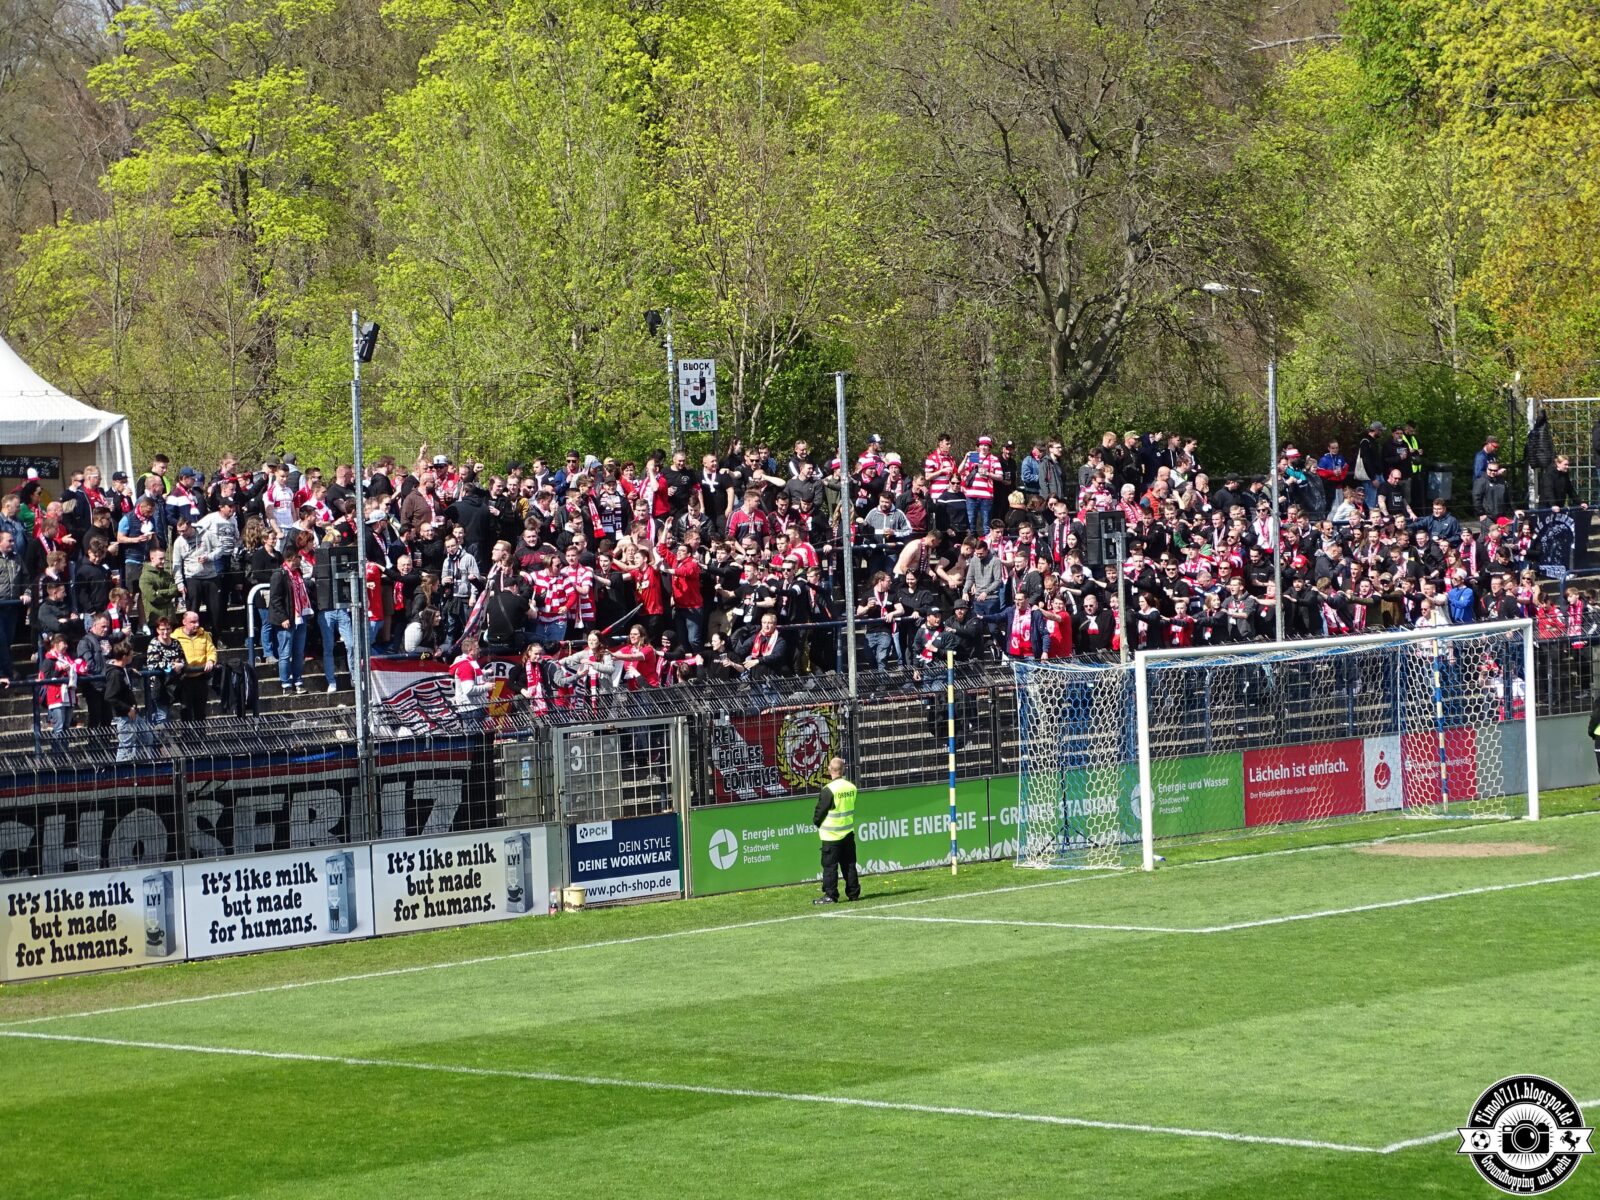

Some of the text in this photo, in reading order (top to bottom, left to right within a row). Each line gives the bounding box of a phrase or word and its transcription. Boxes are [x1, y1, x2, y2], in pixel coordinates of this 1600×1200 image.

[683, 362, 710, 371] BLOCK
[690, 376, 707, 407] J
[713, 725, 736, 747] RED
[570, 745, 583, 771] 3
[718, 745, 764, 769] EAGLES
[723, 766, 780, 792] COTTBUS
[1249, 758, 1349, 782] Lächeln ist einfach.
[1158, 778, 1229, 793] Energie und Wasser
[589, 826, 608, 836] PCH
[858, 816, 909, 842] GRÜNE
[914, 811, 976, 836] ENERGIE
[1000, 801, 1054, 826] GRÜNES
[1059, 796, 1118, 819] STADION
[742, 823, 818, 841] Energie und Wass
[618, 836, 671, 853] DEIN STYLE
[743, 843, 780, 854] Stadtwerke
[418, 848, 453, 872] like
[456, 842, 497, 867] milk
[507, 854, 520, 866] LY!
[578, 851, 672, 872] DEINE WORKWEAR
[743, 855, 771, 864] Potsdam
[234, 868, 272, 892] like
[275, 861, 318, 887] milk
[329, 873, 343, 886] LY!
[406, 868, 482, 897] but made
[44, 888, 85, 913] like
[88, 881, 135, 908] milk
[146, 894, 161, 907] LY!
[221, 888, 302, 917] but made
[393, 893, 496, 922] for humans.
[29, 909, 118, 940] but made
[209, 913, 318, 944] for humans.
[15, 935, 133, 968] for humans.
